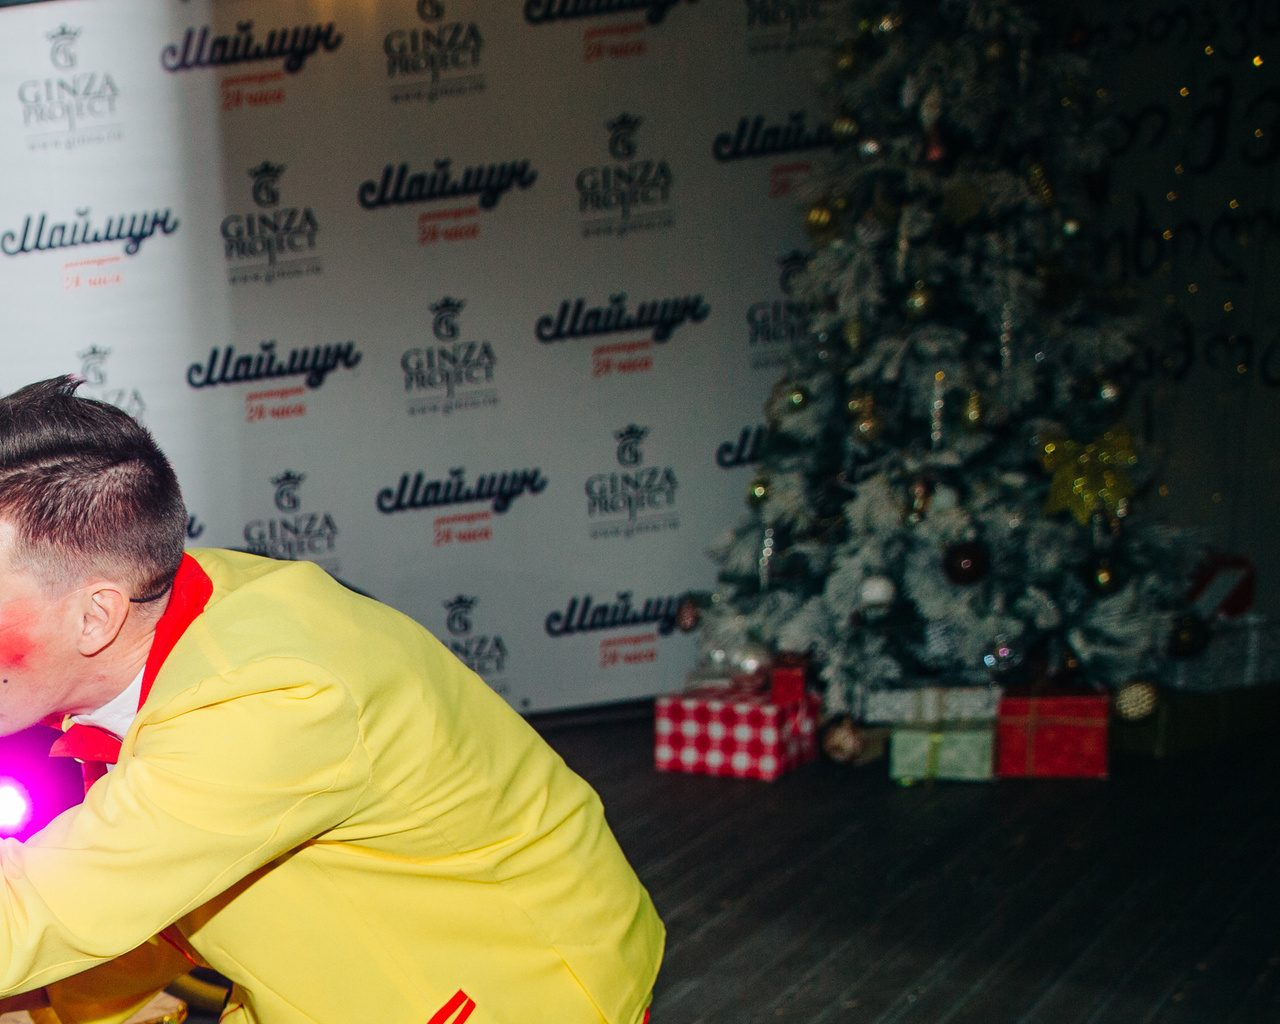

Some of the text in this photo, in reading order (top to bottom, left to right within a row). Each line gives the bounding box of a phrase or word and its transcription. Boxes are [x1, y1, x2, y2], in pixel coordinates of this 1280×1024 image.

[20, 72, 119, 106] GINZA
[23, 96, 117, 132] PROJECT
[0, 208, 179, 257] Маймун
[222, 207, 320, 241] GINZA
[224, 232, 317, 266] PROJECT
[401, 341, 496, 375] GINZA
[404, 364, 495, 398] PROJECT
[244, 513, 338, 546] GINZA
